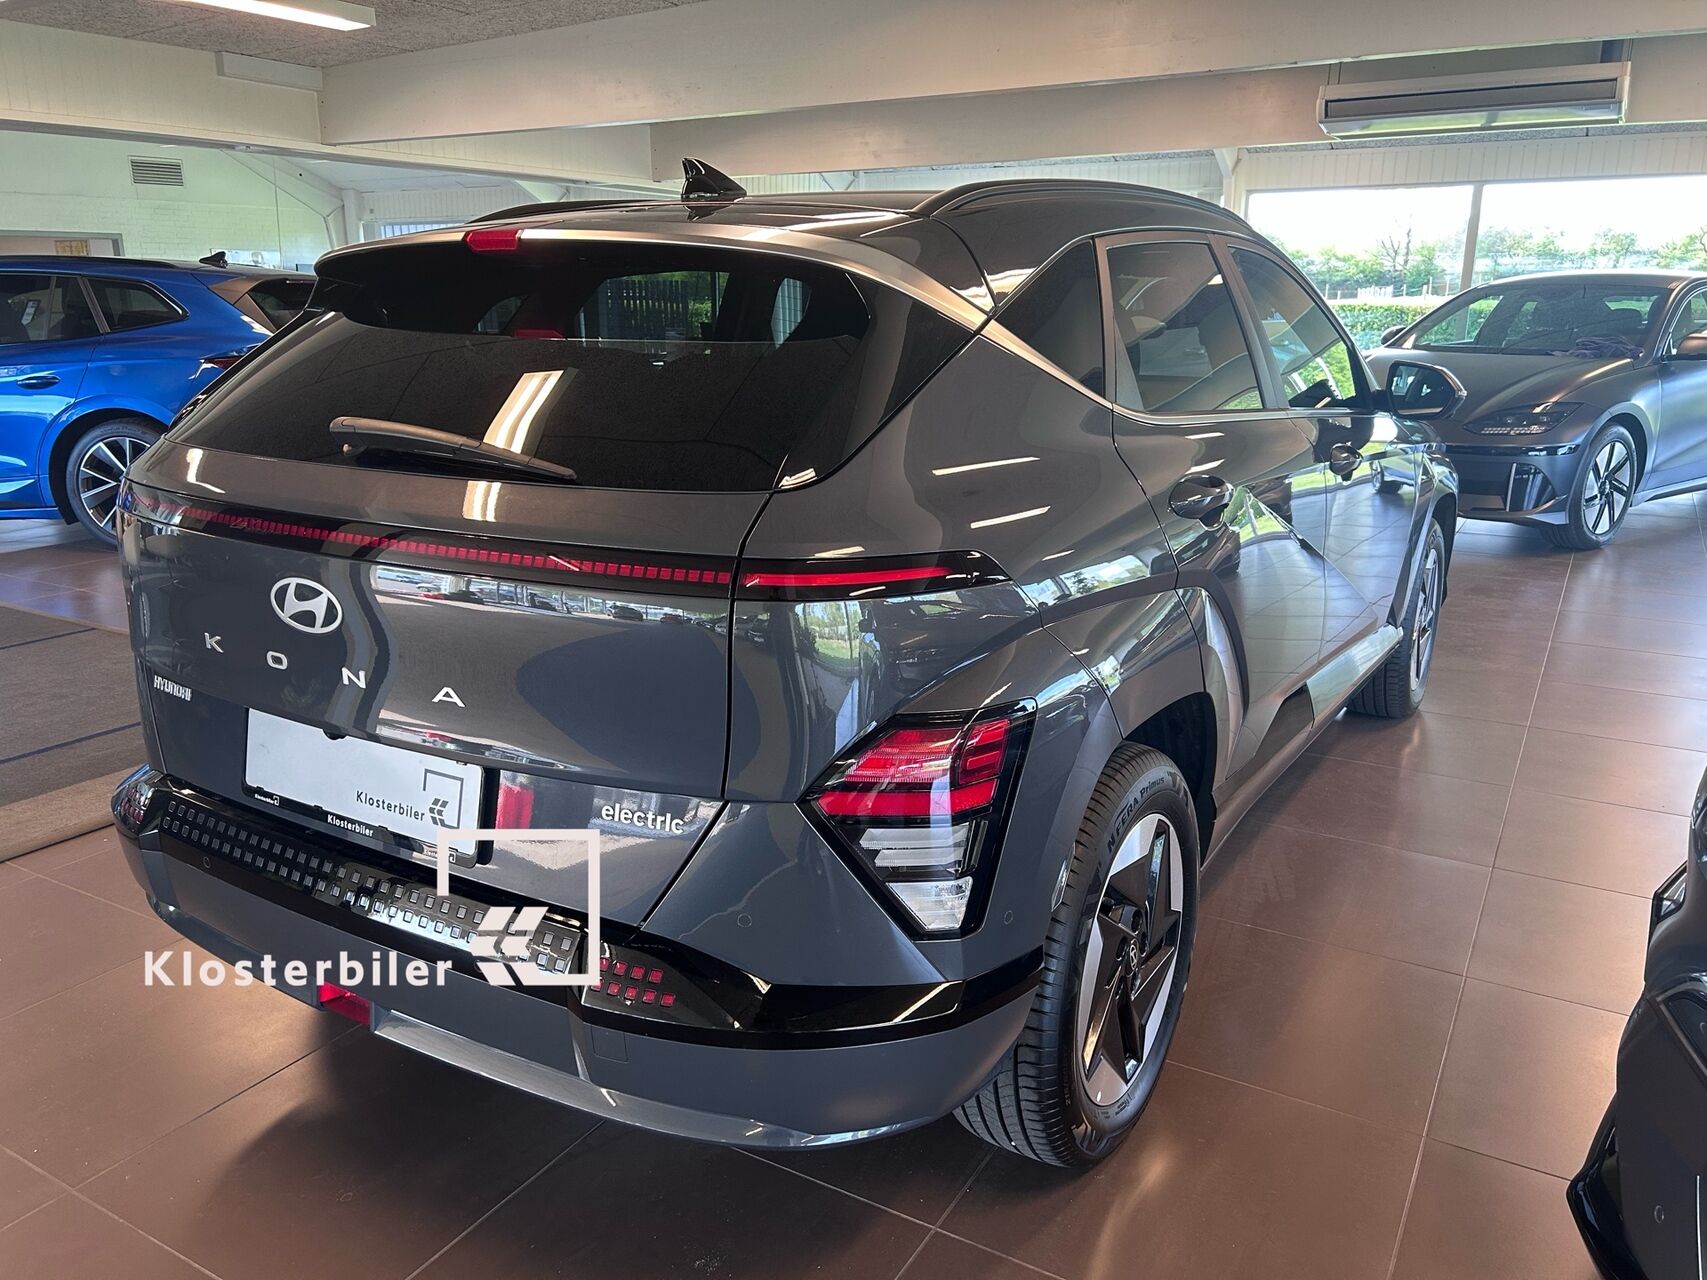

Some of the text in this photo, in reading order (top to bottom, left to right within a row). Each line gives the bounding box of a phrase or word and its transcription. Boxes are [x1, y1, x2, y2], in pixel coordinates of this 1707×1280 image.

[153, 674, 192, 702] HYUNDAI
[356, 790, 425, 821] Klosterbiler
[601, 803, 684, 835] electric
[327, 814, 374, 837] Klosterbiler
